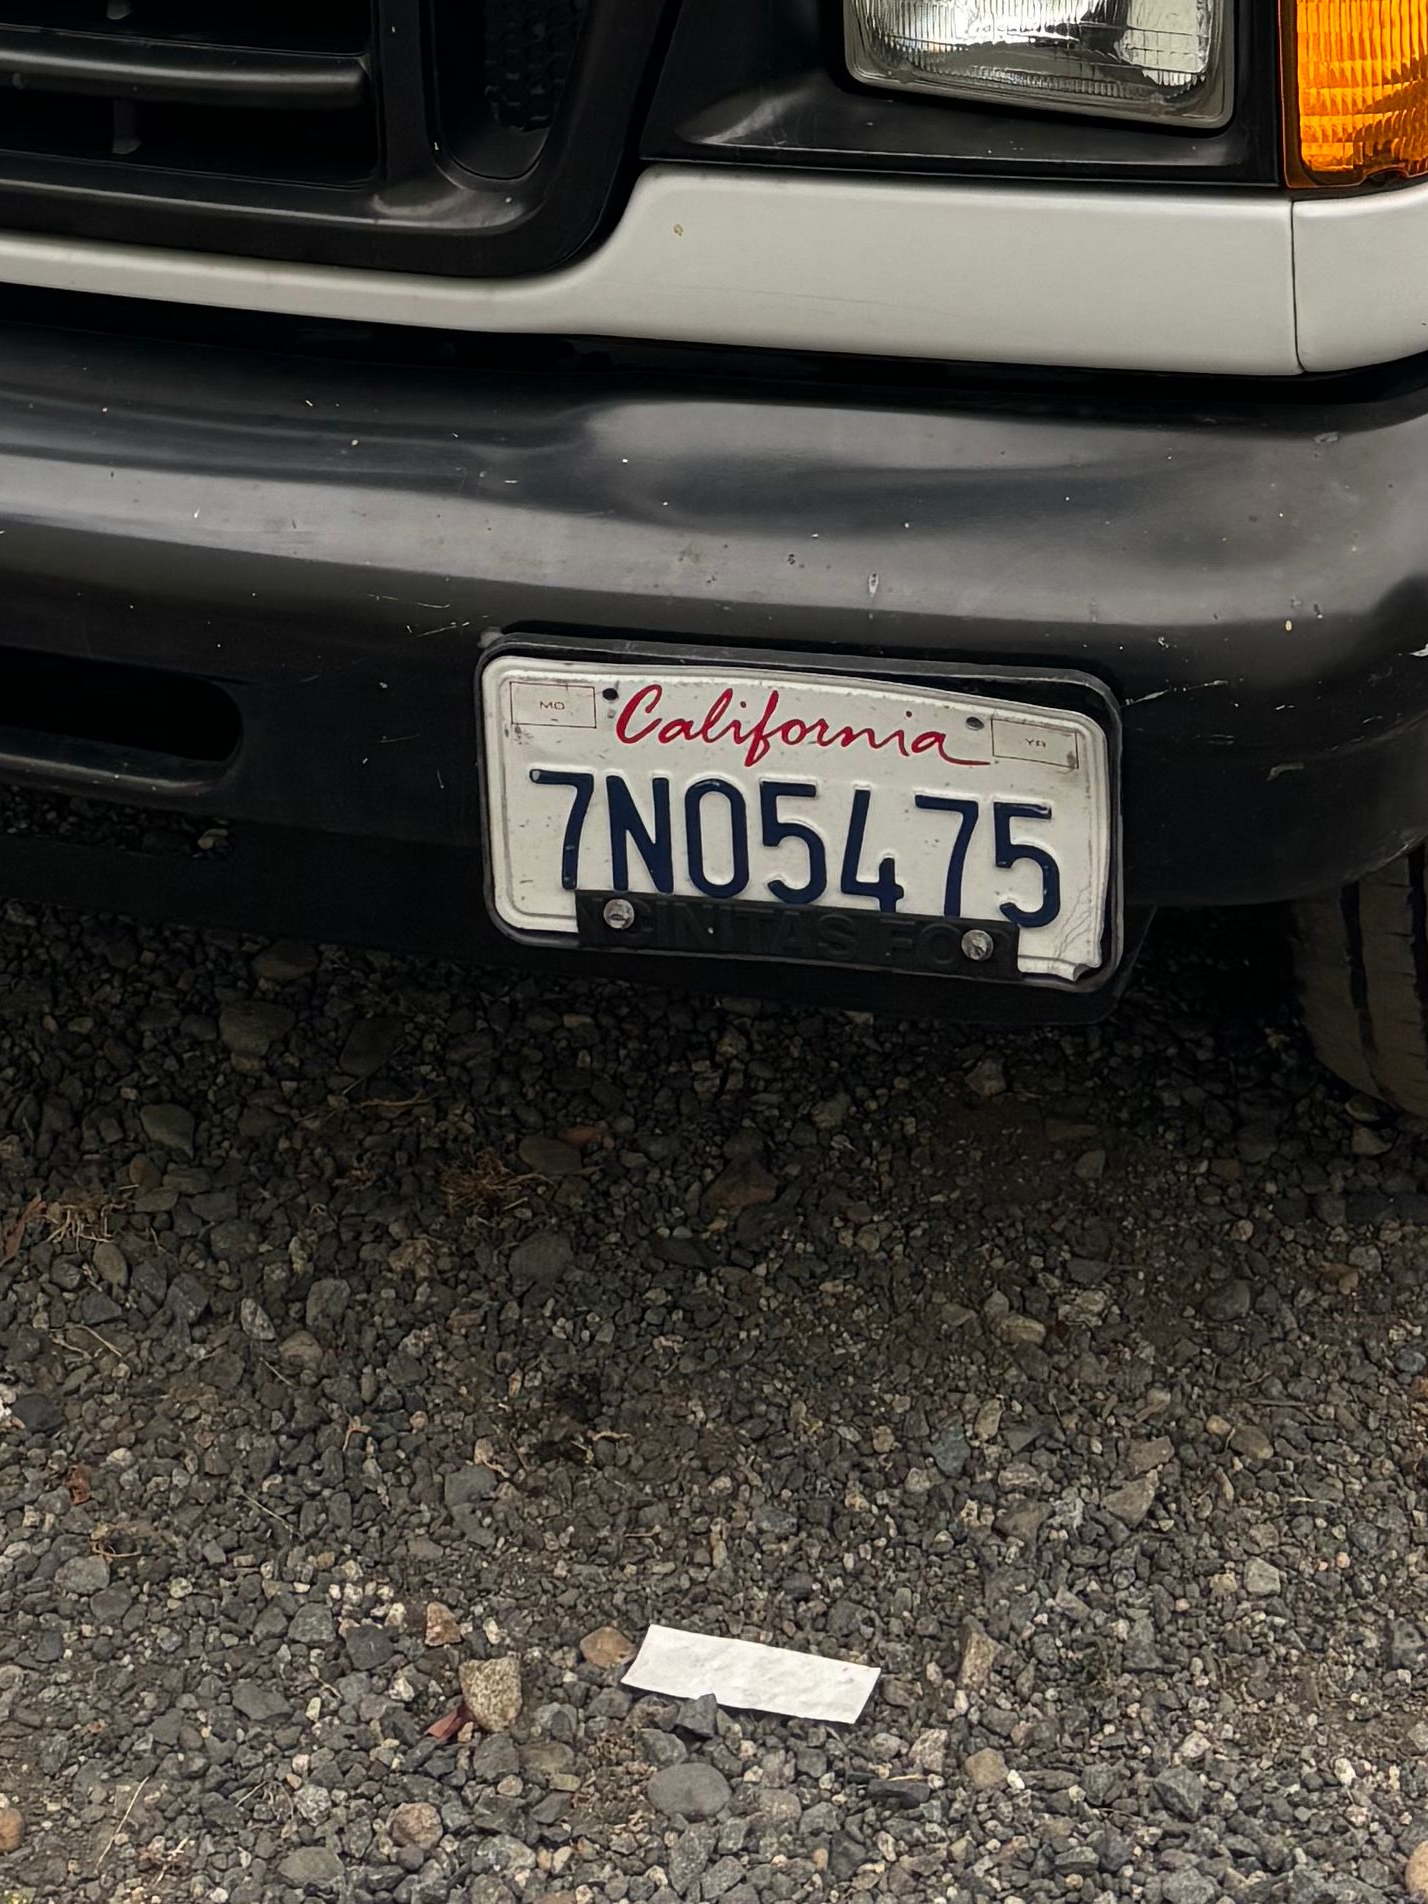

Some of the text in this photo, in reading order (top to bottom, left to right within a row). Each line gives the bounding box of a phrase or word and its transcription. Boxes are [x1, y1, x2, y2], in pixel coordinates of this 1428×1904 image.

[539, 700, 566, 711] MO
[614, 682, 991, 768] California
[528, 767, 1062, 930] 7N05475
